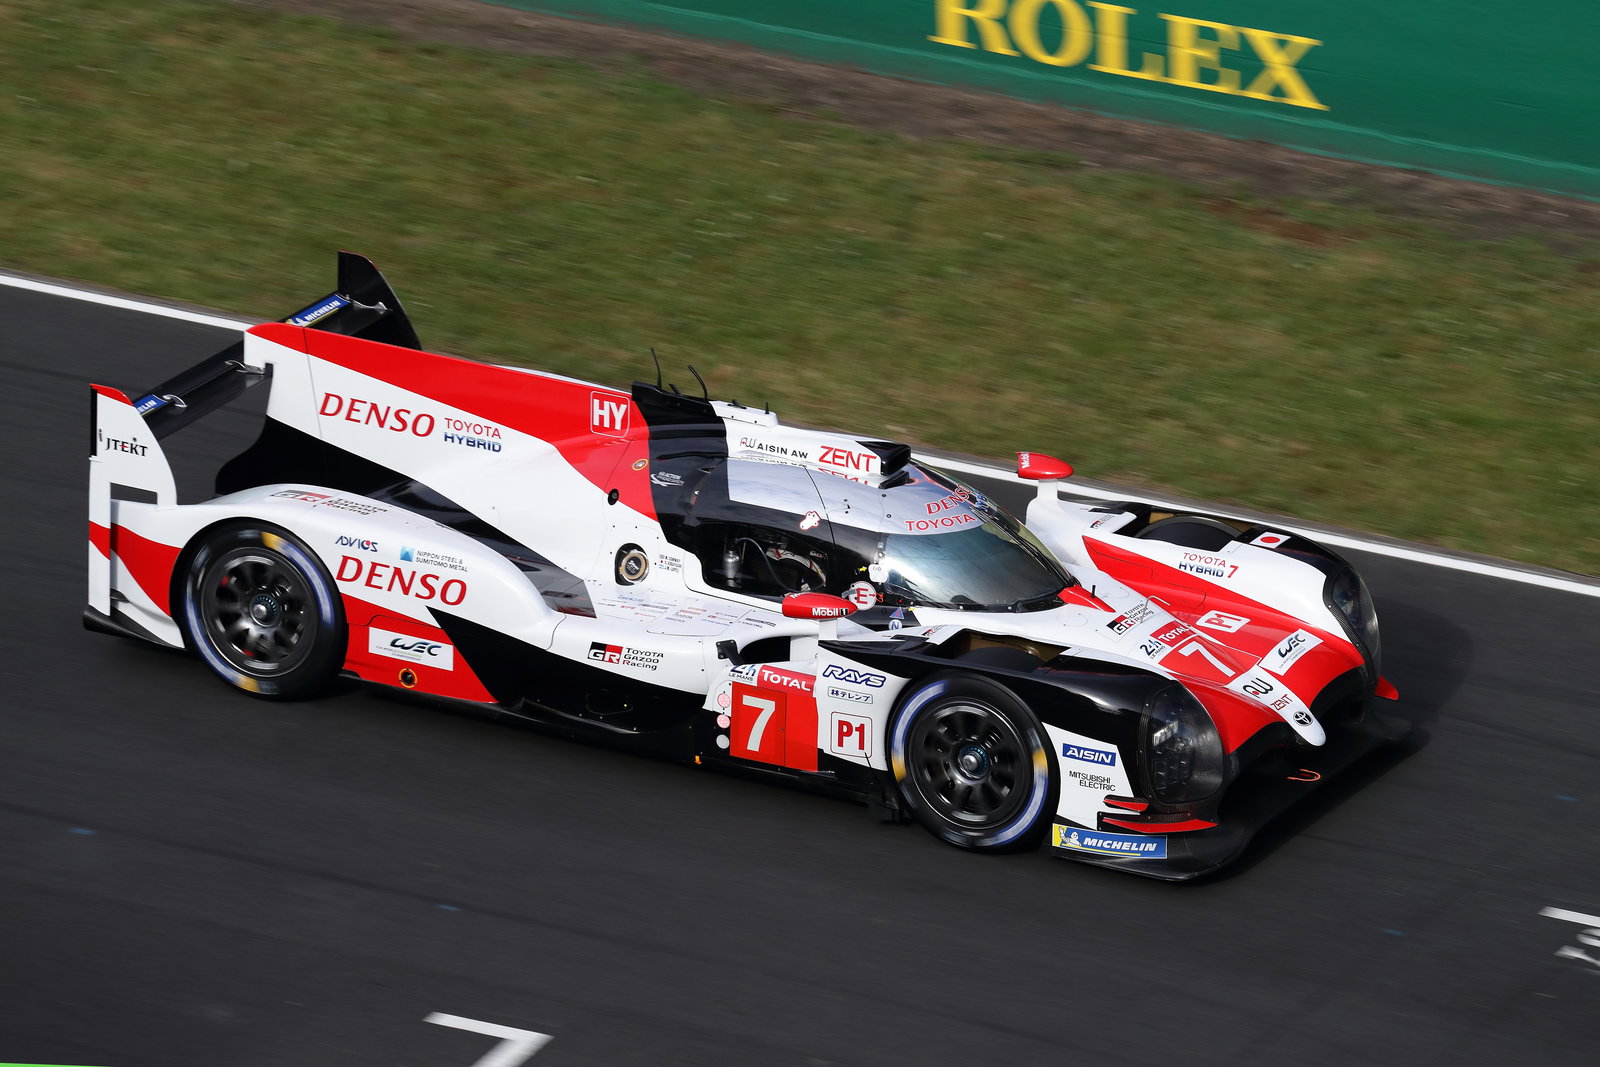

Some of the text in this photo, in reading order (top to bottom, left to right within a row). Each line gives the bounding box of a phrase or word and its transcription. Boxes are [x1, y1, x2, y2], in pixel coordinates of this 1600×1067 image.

[928, 0, 1331, 111] ROLEX
[304, 299, 341, 322] MICHELIN
[319, 392, 435, 438] DENSO
[593, 398, 628, 431] HY
[444, 417, 502, 440] TOYOTA
[105, 437, 148, 457] JTEKT
[444, 432, 502, 453] HYBRID
[757, 443, 788, 455] AISIN
[791, 450, 809, 459] AW
[819, 445, 877, 472] ZENT
[905, 513, 976, 532] TOYOTA
[415, 556, 468, 573] SUMITOMO METAL
[416, 550, 440, 560] NIPPON
[440, 555, 458, 564] STEEL
[1183, 552, 1226, 568] TOYOTA
[1178, 561, 1224, 578] HYBRID
[1227, 564, 1239, 579] 7
[335, 554, 467, 606] DENSO
[857, 587, 869, 605] E
[811, 607, 839, 617] Mobil
[1204, 613, 1243, 629] P1
[1157, 625, 1191, 642] TOTAL
[390, 637, 442, 657] WEC
[625, 647, 664, 658] TOYOTA
[1277, 633, 1306, 658] WEC
[588, 649, 620, 664] GR
[622, 659, 658, 671] Racing
[623, 653, 660, 664] GAZOO
[1177, 640, 1236, 678] 7
[761, 669, 811, 692] TOTAL
[822, 664, 887, 688] RAYS
[742, 694, 776, 752] 7
[837, 719, 866, 751] P1
[1066, 747, 1112, 764] AISIN
[1068, 770, 1111, 784] MITSUBISHI
[1079, 779, 1116, 792] ELECTRIC
[1083, 837, 1157, 852] MICHELIN
